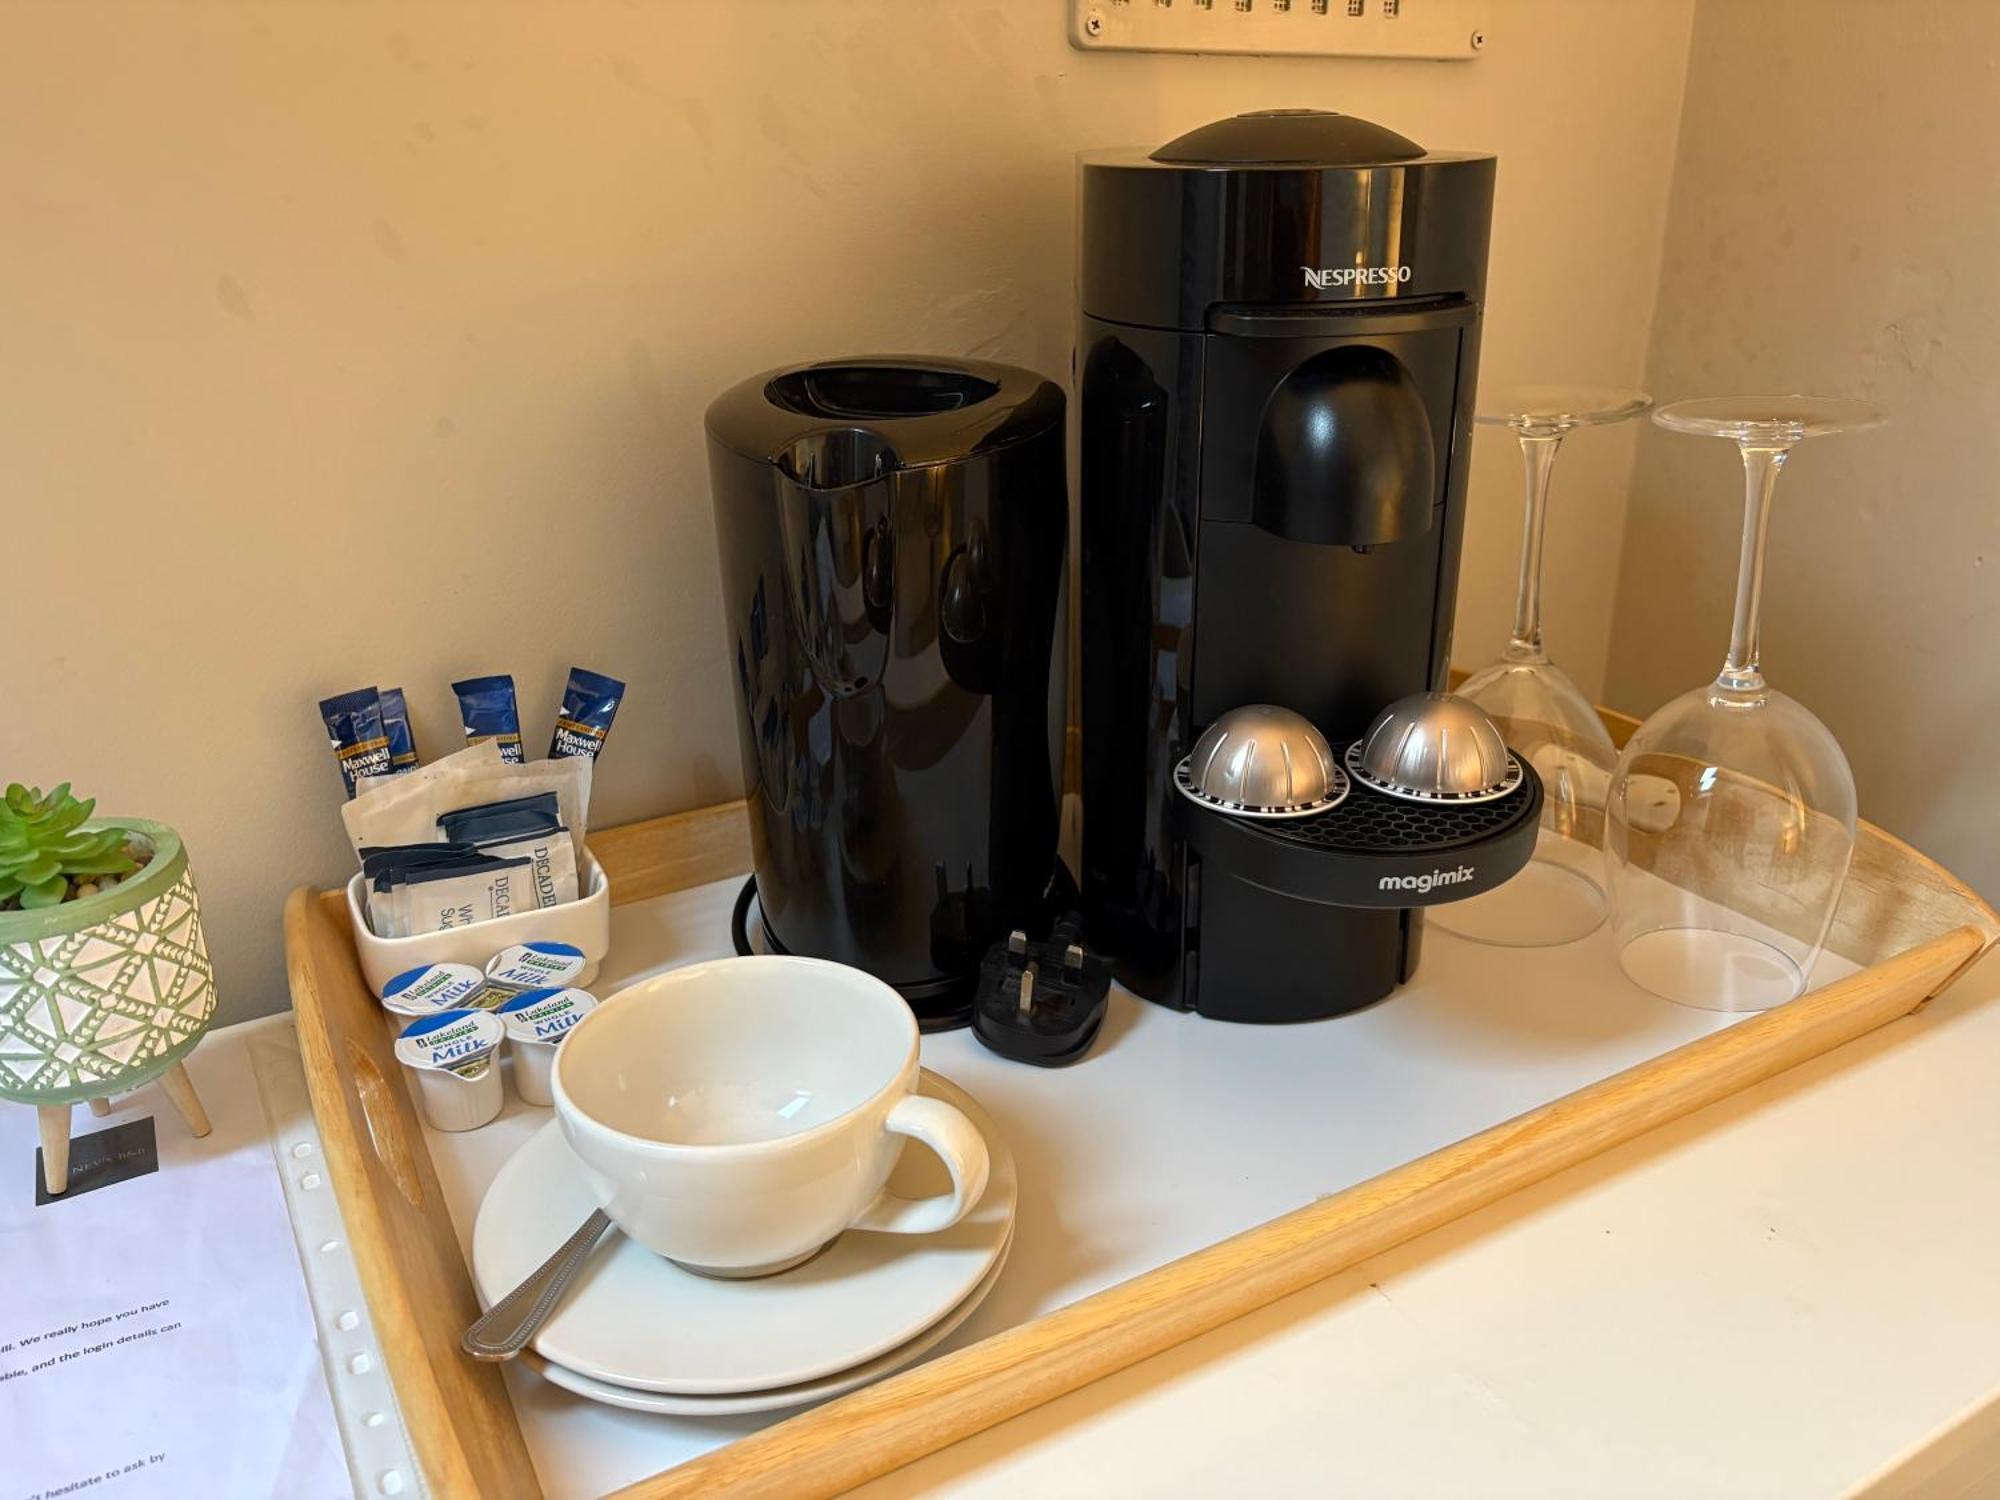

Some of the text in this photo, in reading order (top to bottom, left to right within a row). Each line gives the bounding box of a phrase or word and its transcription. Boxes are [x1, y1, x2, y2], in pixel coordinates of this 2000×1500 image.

[1300, 266, 1411, 290] NESPRESSO
[556, 728, 603, 752] Maxwell
[557, 741, 595, 758] House
[343, 748, 390, 774] Maxwell
[350, 761, 389, 783] House
[1378, 865, 1475, 893] magimix
[431, 979, 477, 1006] Milk
[432, 1039, 489, 1063] Milk
[19, 1336, 41, 1347] We
[44, 1325, 78, 1340] really
[81, 1316, 113, 1330] hope
[115, 1309, 138, 1321] you
[141, 1299, 170, 1313] have
[31, 1357, 56, 1373] and
[59, 1350, 81, 1363] the
[83, 1341, 114, 1355] login
[117, 1328, 158, 1345] details
[160, 1322, 182, 1333] can
[45, 1475, 102, 1500] hesitate
[106, 1470, 120, 1480] to
[123, 1459, 145, 1473] ask
[149, 1452, 166, 1464] by
